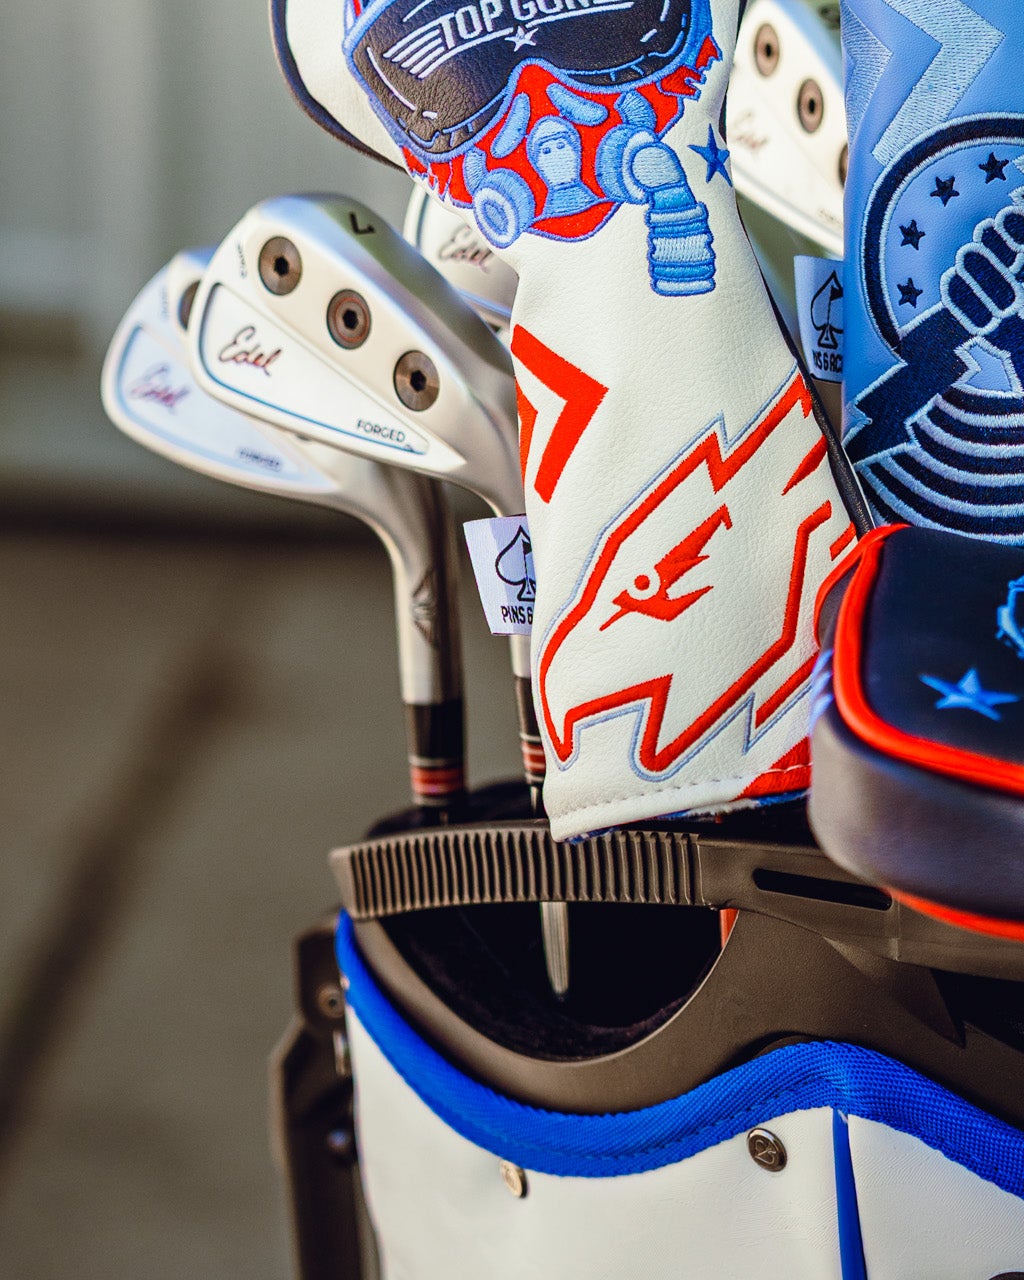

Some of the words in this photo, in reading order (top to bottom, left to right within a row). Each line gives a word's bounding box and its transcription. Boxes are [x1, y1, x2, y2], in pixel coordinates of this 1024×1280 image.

[219, 326, 281, 376] Edel
[357, 419, 406, 442] FORGED
[501, 606, 526, 624] PINS
